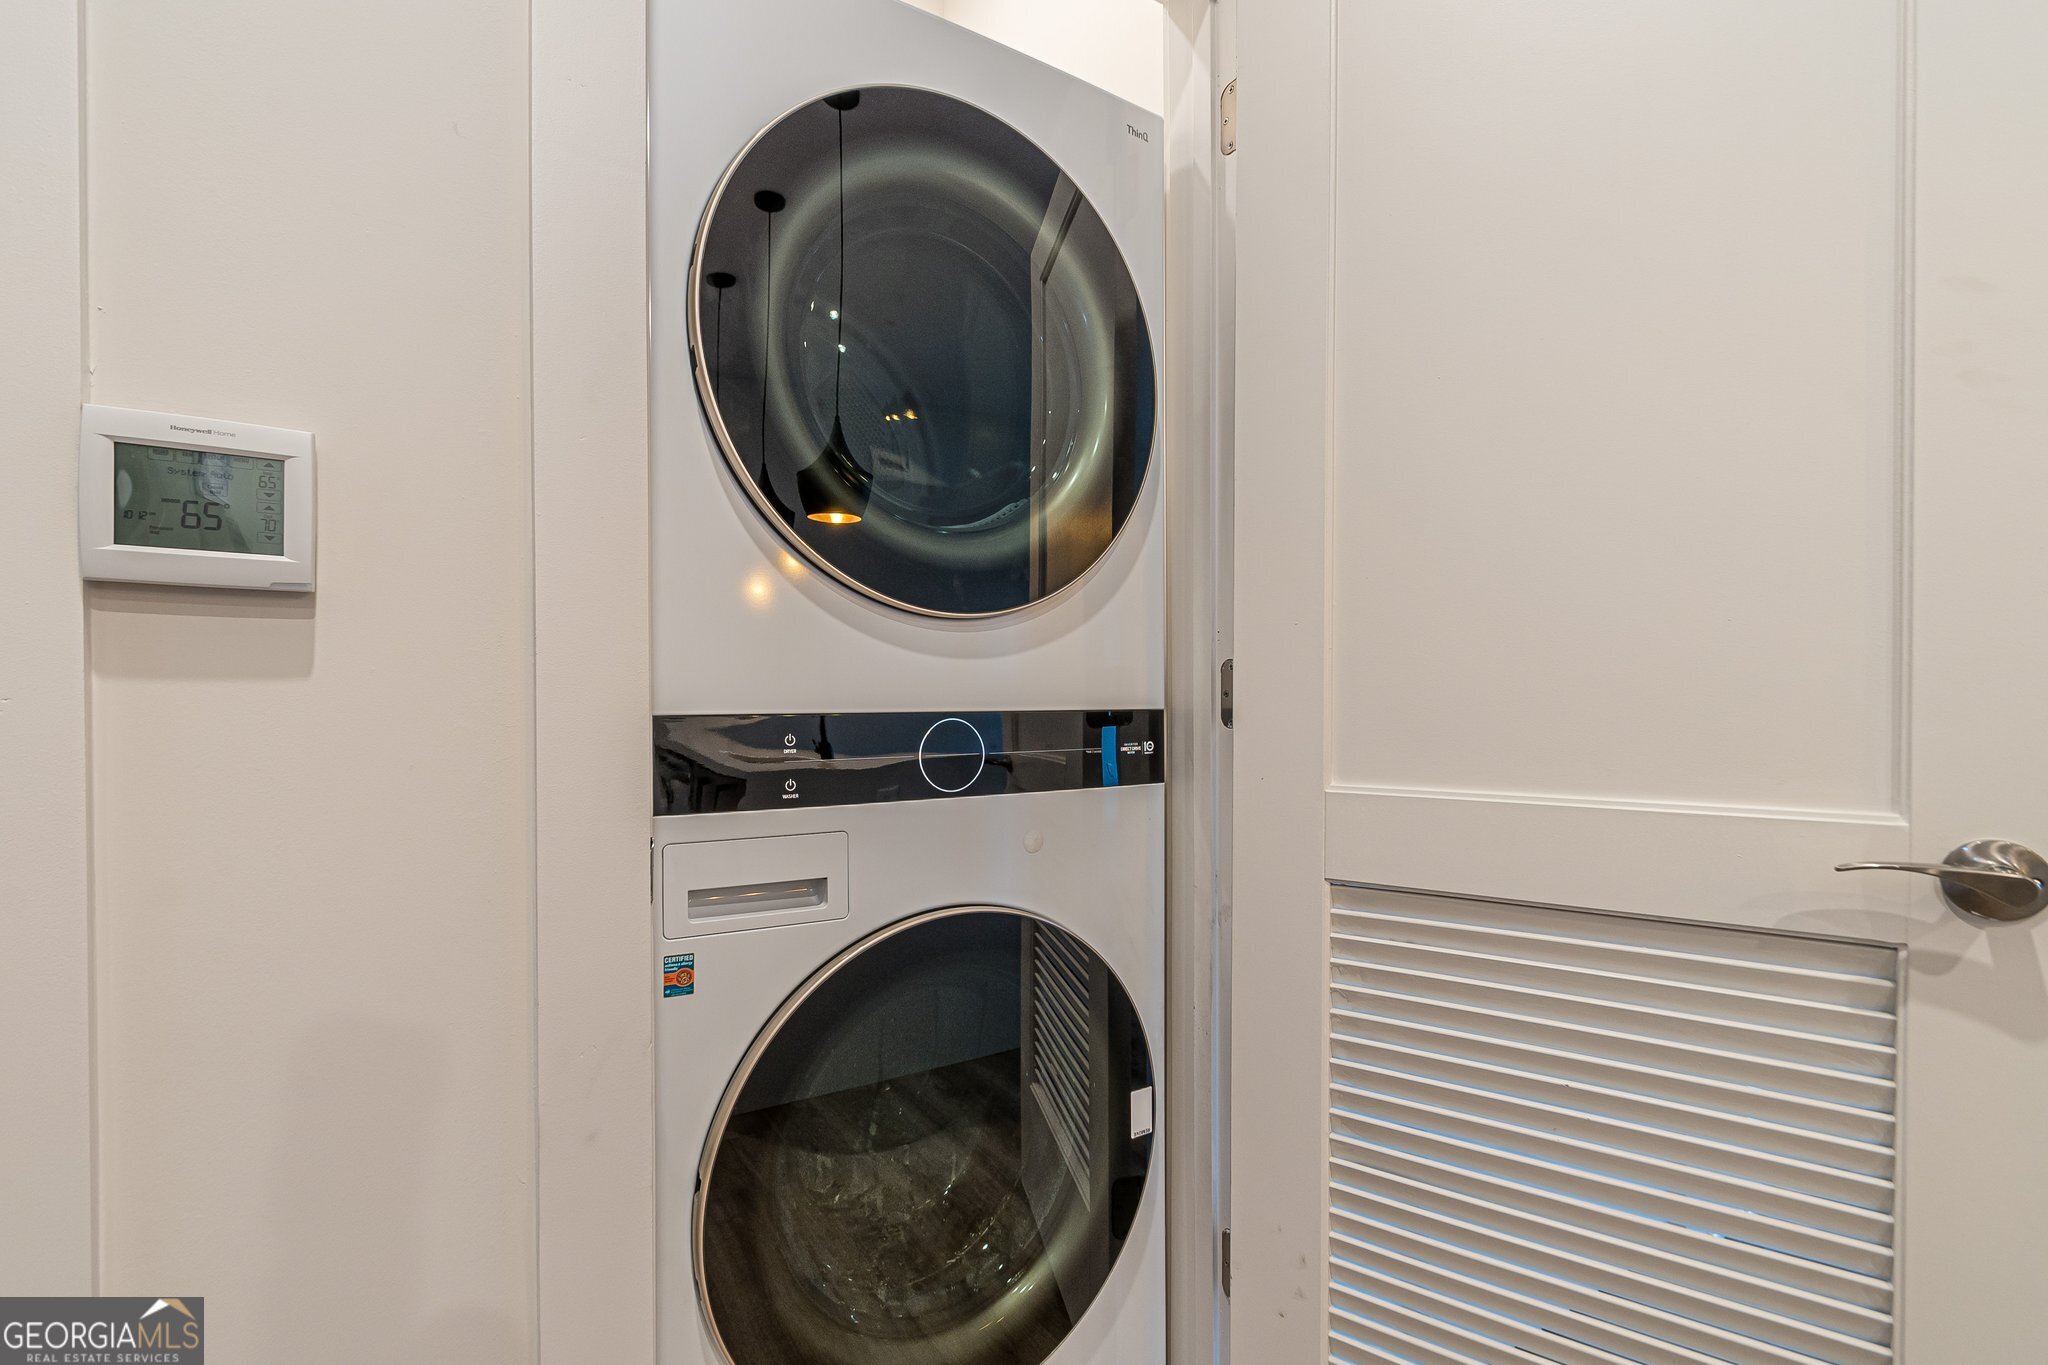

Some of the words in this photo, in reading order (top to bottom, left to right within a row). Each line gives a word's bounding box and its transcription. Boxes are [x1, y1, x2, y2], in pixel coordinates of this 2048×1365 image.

[1126, 123, 1149, 143] ThinQ
[169, 424, 212, 435] Honeywell
[213, 430, 237, 438] Home
[664, 955, 694, 963] CERTIFIED
